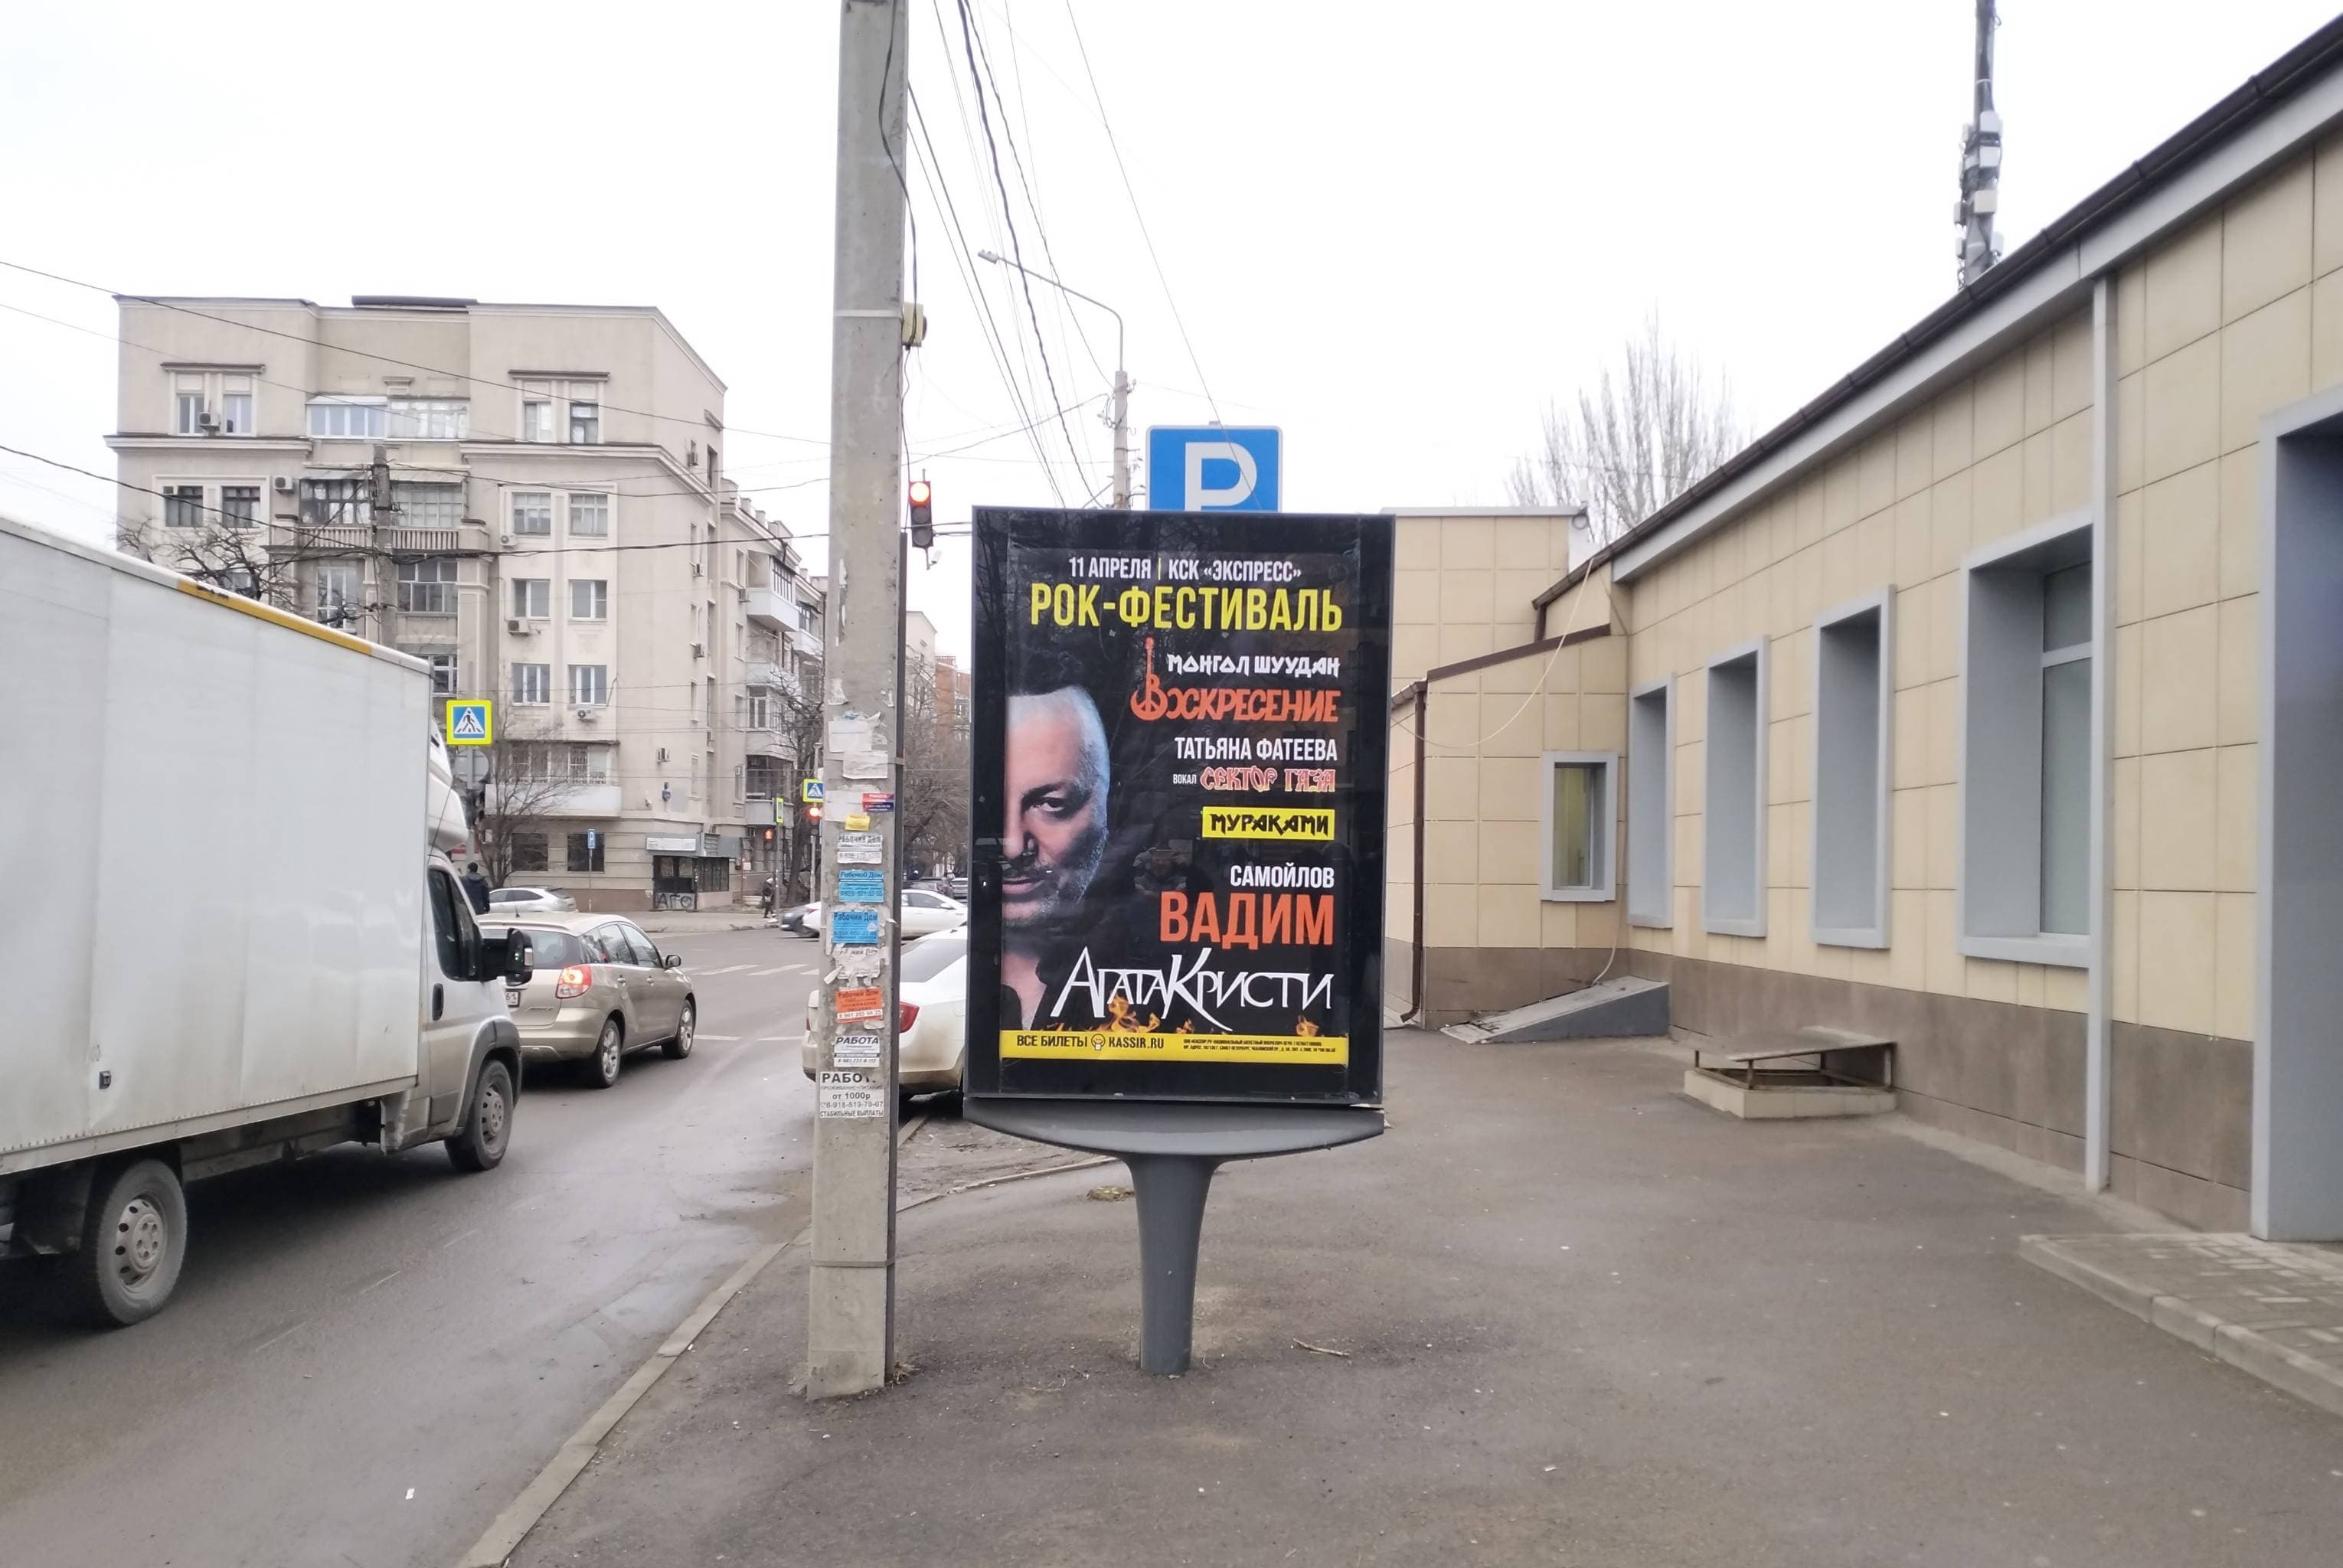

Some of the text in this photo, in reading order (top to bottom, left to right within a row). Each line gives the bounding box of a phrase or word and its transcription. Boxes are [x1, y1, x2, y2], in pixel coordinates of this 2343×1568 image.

[1185, 442, 1257, 511] P
[1069, 557, 1302, 582] 11 АПРЕЛЯ КСК «ЭКСПРЕСС»
[1031, 583, 1342, 632] РОК-ФЕСТИВАЛЬ
[1175, 737, 1338, 761] ТАТЬЯНА ФАТЕЕВА
[1173, 766, 1335, 792] ВОКАЛ СЕКТОР ГАЗА
[1210, 814, 1328, 836] МУРАКАМИ
[1230, 862, 1335, 888] САМОЙЛОВ
[1160, 890, 1333, 950] ВАДИМ
[1017, 1034, 1088, 1047] ВСЕ БИЛЕТЫ
[1108, 1037, 1164, 1049] KASSIR.RU
[822, 1073, 876, 1083] РАБО
